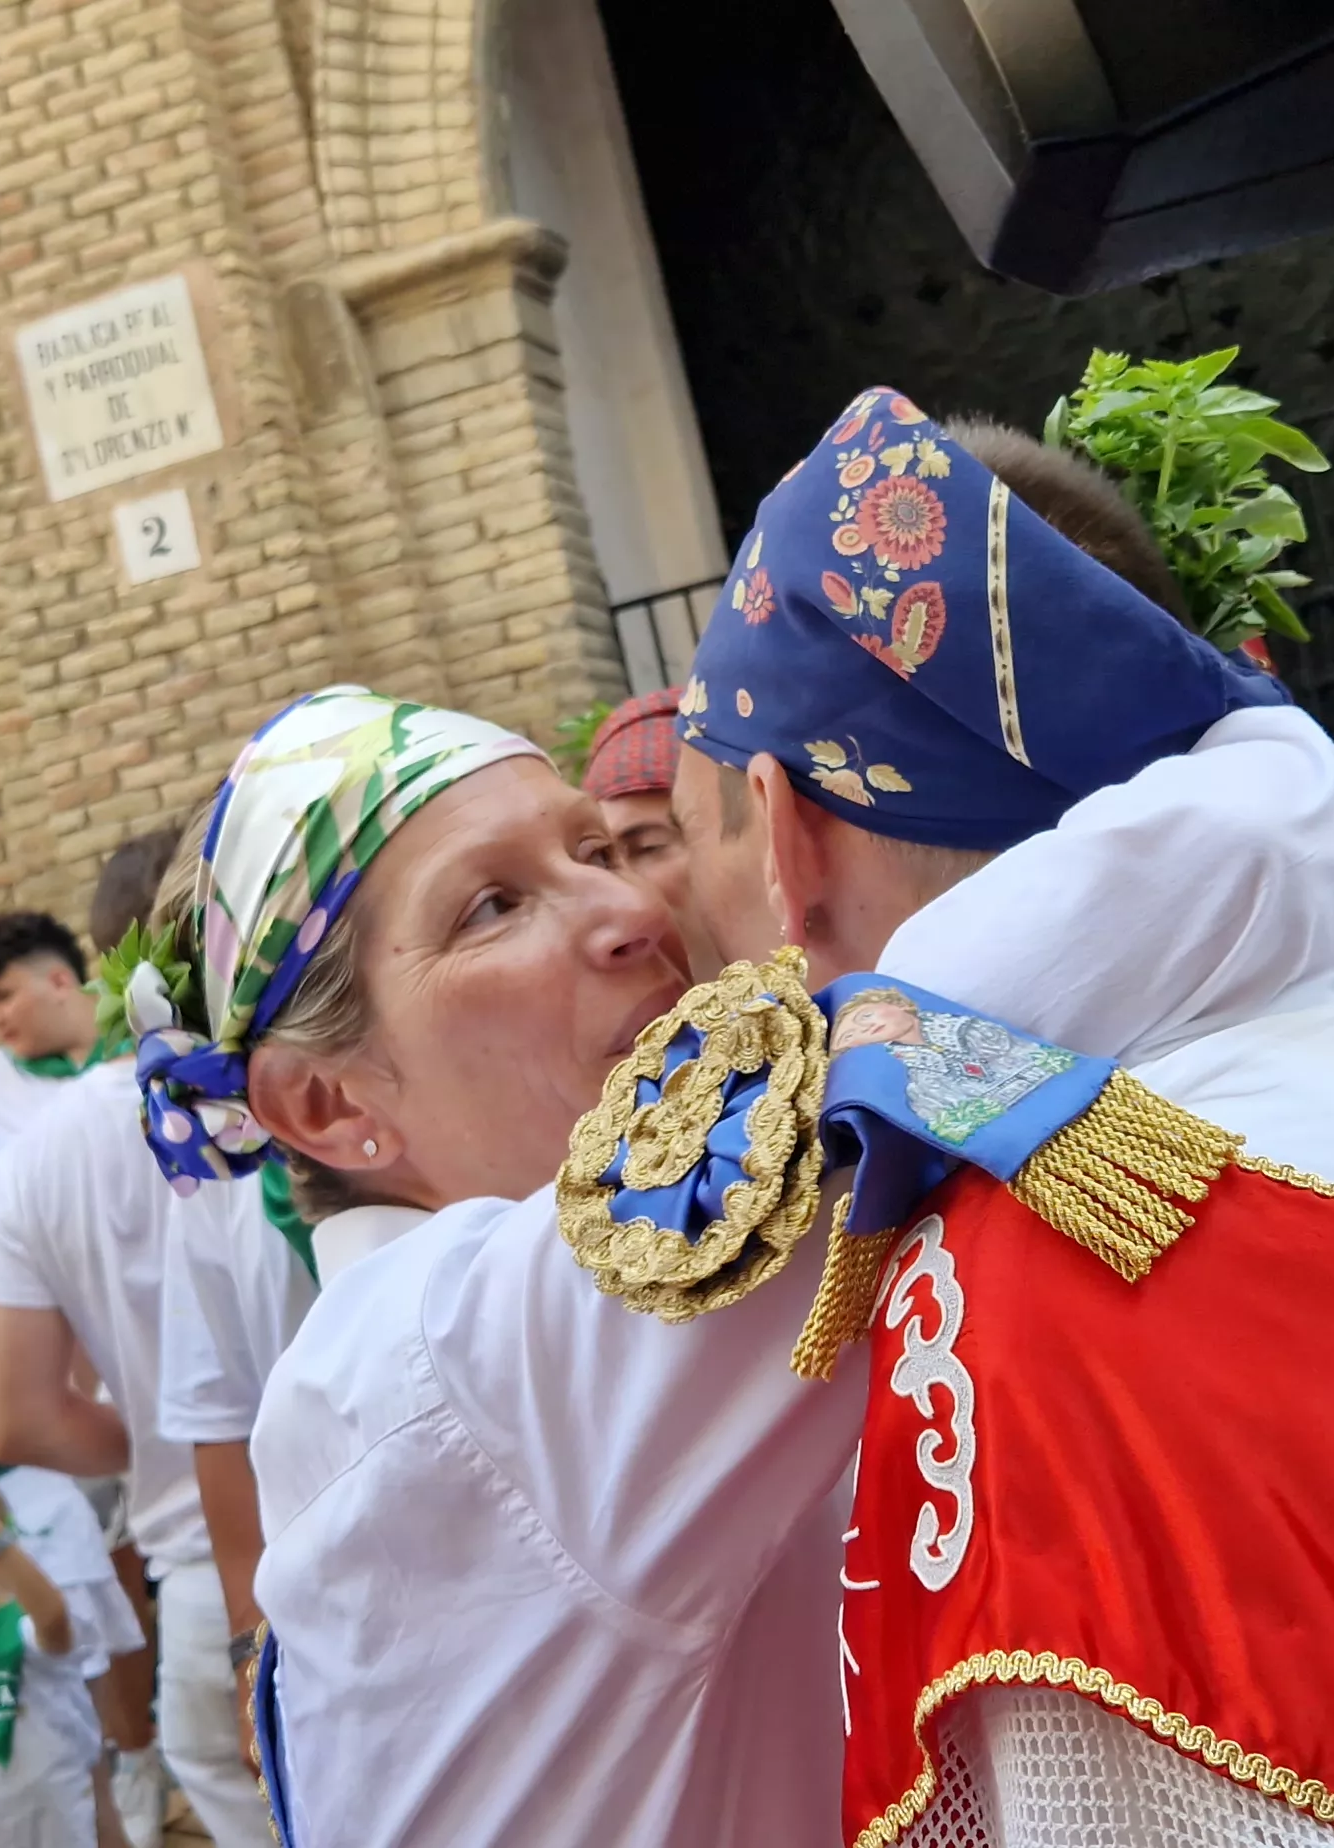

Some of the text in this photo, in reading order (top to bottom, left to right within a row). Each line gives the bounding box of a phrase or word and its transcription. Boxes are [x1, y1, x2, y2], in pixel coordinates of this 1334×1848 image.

[43, 377, 57, 401] Y
[107, 391, 136, 422] DE
[83, 419, 173, 472] LORENZO
[141, 515, 172, 558] 2
